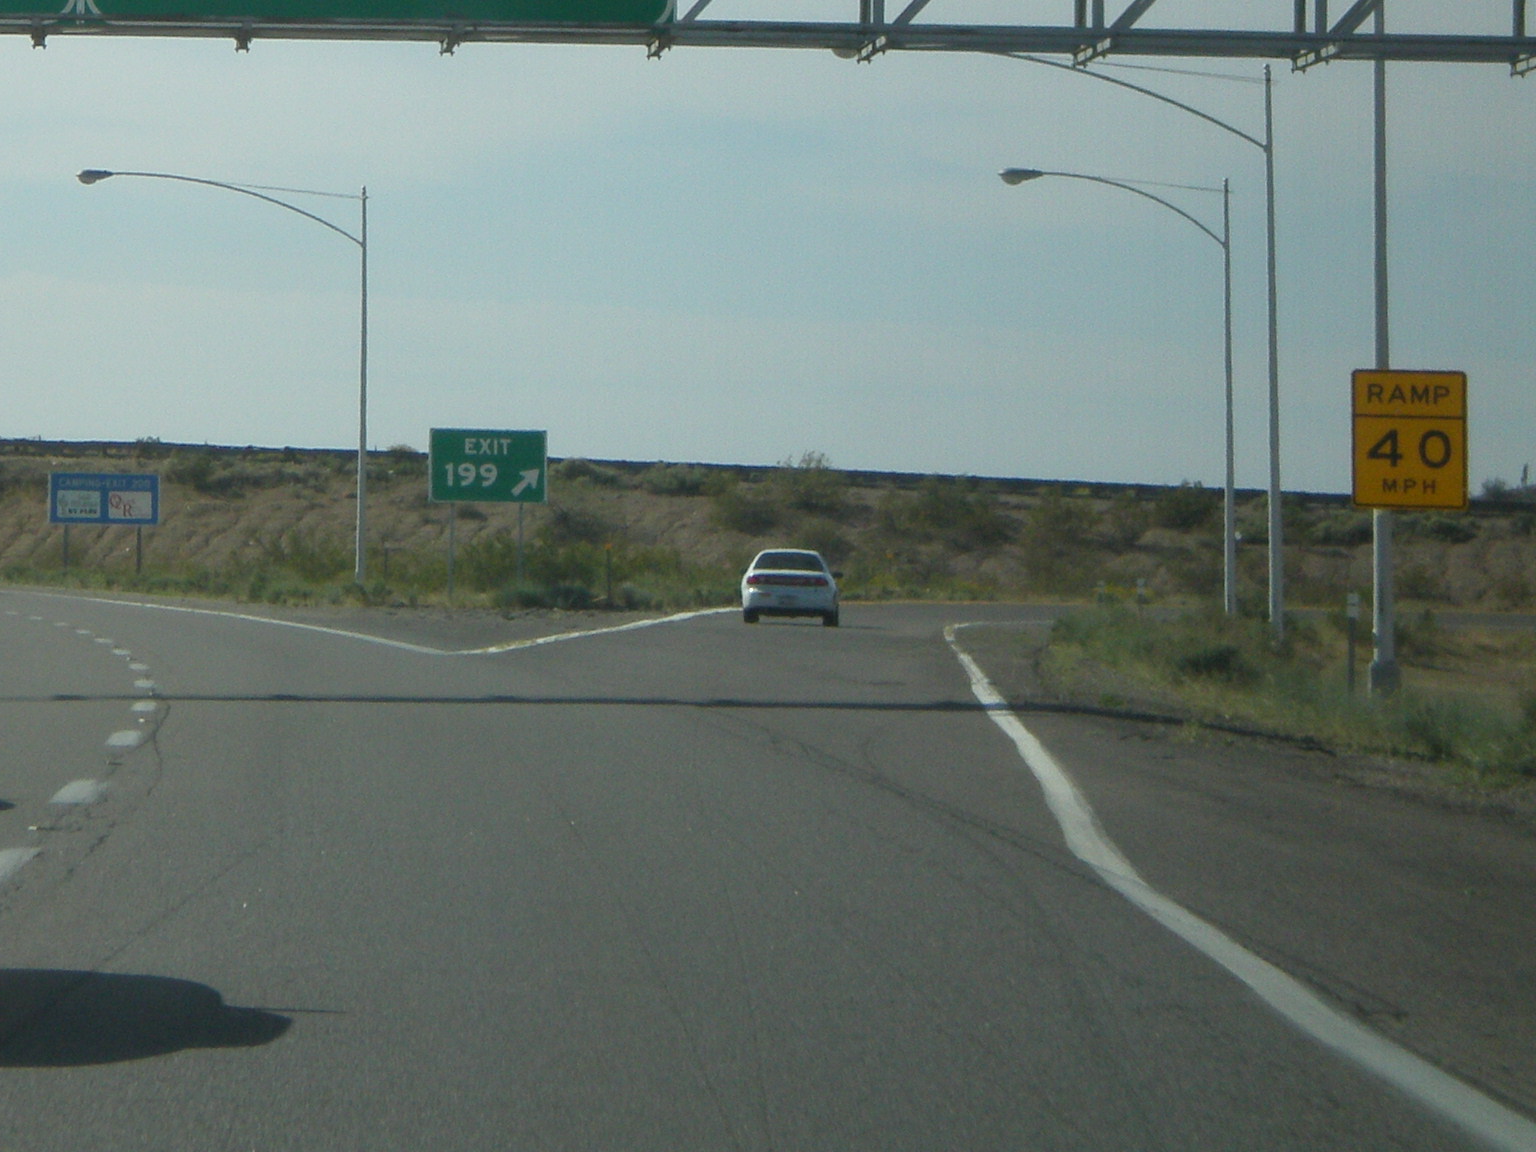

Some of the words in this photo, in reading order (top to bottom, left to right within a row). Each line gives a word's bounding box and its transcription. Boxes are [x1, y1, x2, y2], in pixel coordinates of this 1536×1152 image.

[1366, 383, 1451, 406] RAMP
[464, 437, 512, 455] EXIT
[1367, 428, 1453, 470] 40
[444, 462, 498, 487] 199
[1382, 478, 1437, 495] MPH
